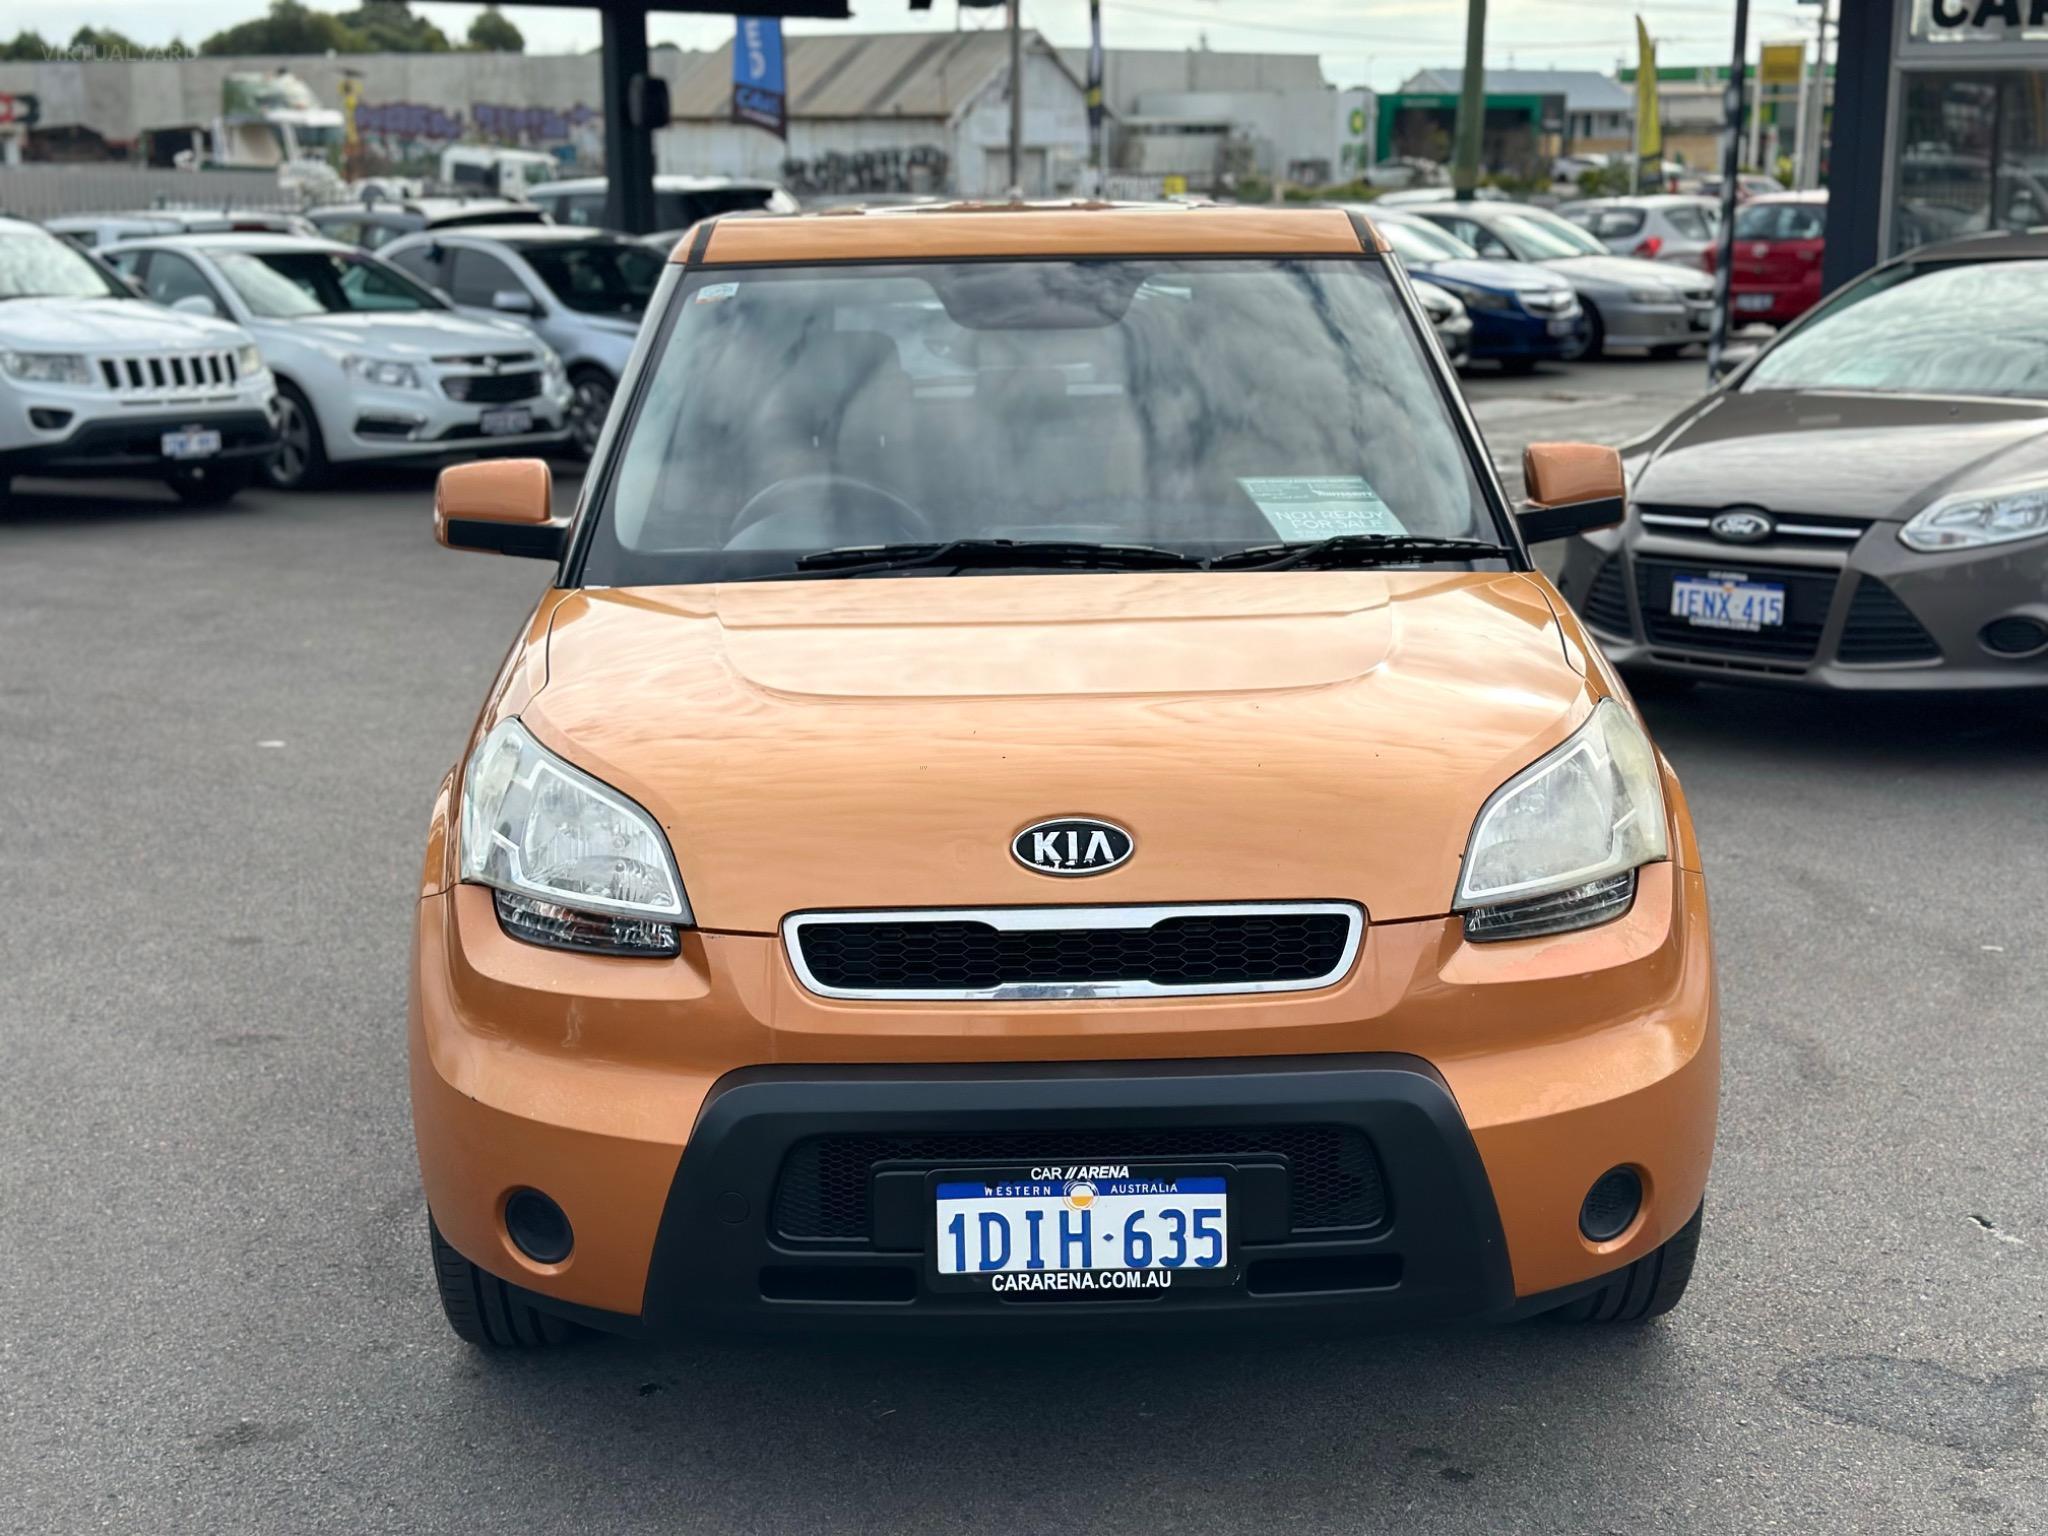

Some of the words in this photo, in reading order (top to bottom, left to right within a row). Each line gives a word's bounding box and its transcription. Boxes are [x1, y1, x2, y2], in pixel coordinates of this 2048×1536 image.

[1276, 511, 1316, 520] NOT
[1321, 511, 1384, 520] READY
[1293, 520, 1333, 529] FOR
[1033, 831, 1115, 864] KIA
[984, 1186, 1052, 1197] WESTERN
[1110, 1183, 1178, 1194] AUSTRALIA
[991, 1271, 1172, 1291] CARARENA.COM.AU
